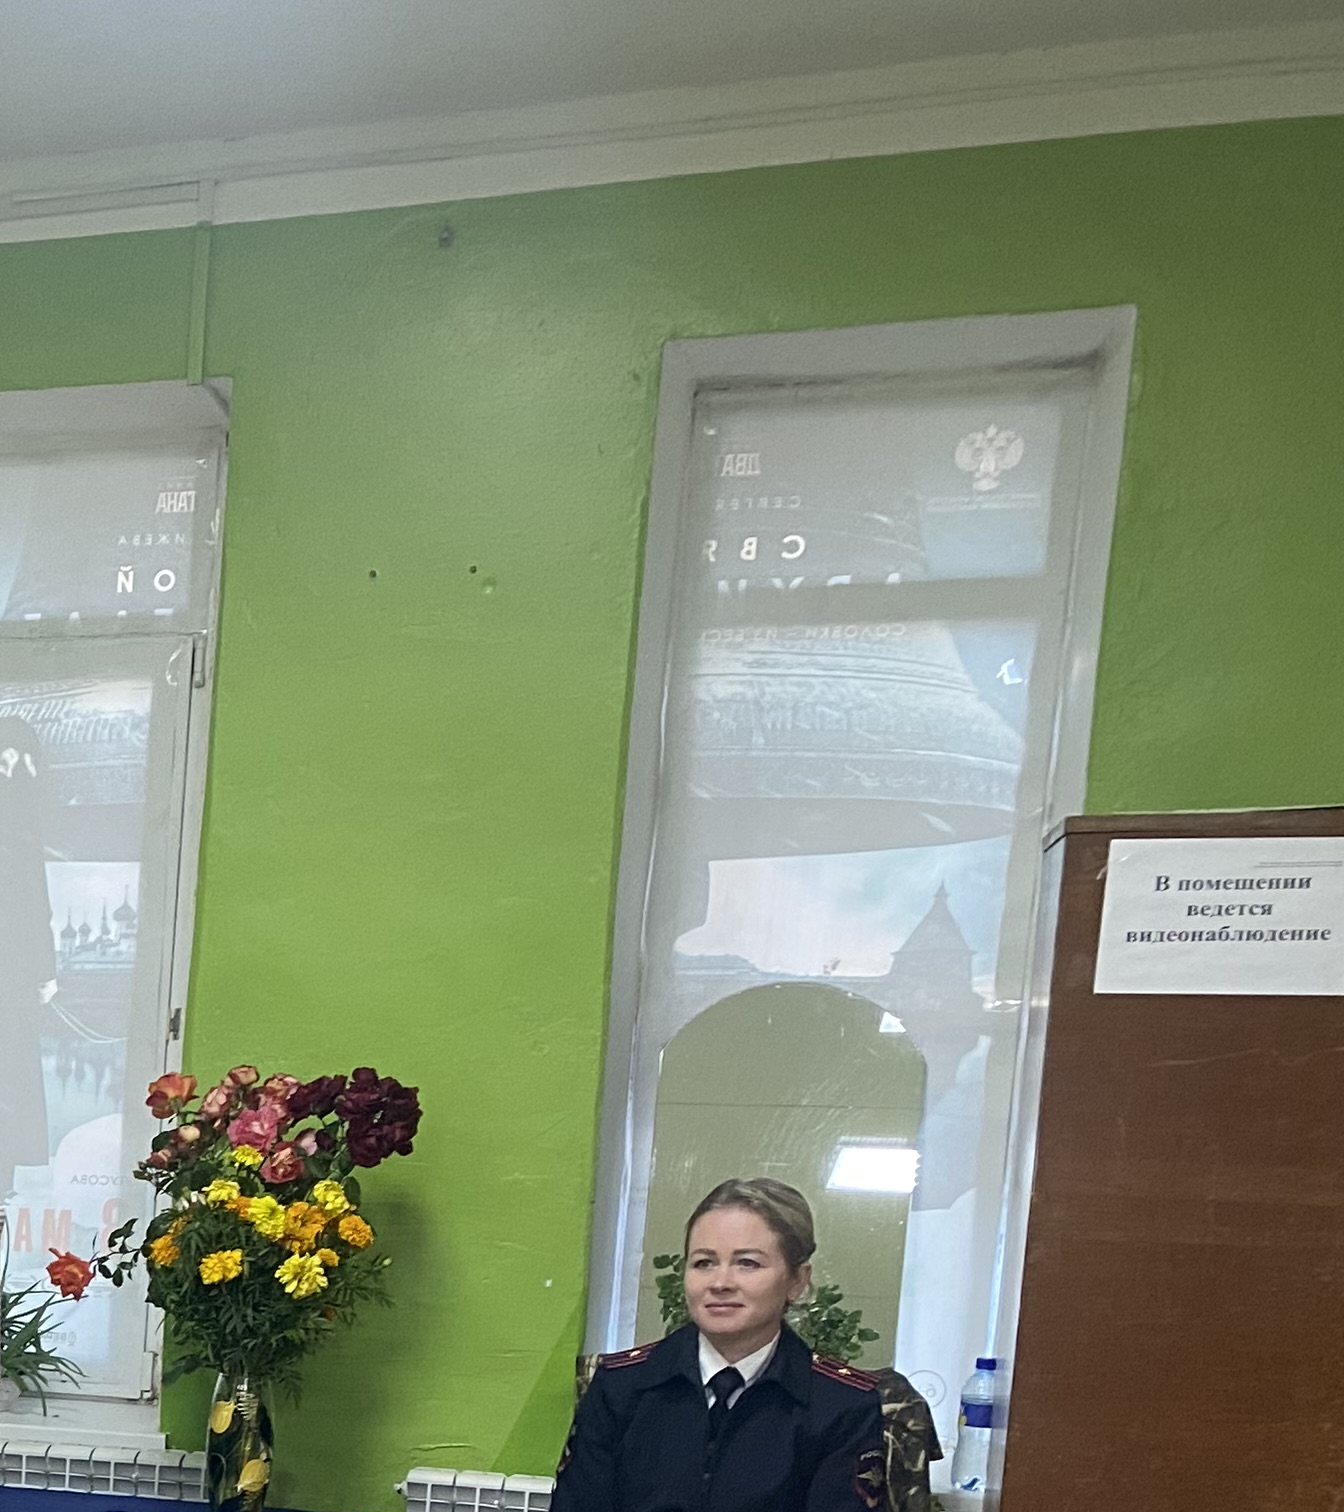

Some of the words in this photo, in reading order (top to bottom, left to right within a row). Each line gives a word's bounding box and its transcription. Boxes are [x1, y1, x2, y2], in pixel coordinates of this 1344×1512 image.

[1154, 875, 1171, 892] В
[1177, 875, 1313, 893] помещении
[1186, 902, 1274, 918] ведется
[1125, 925, 1332, 944] видеонаблюдение
